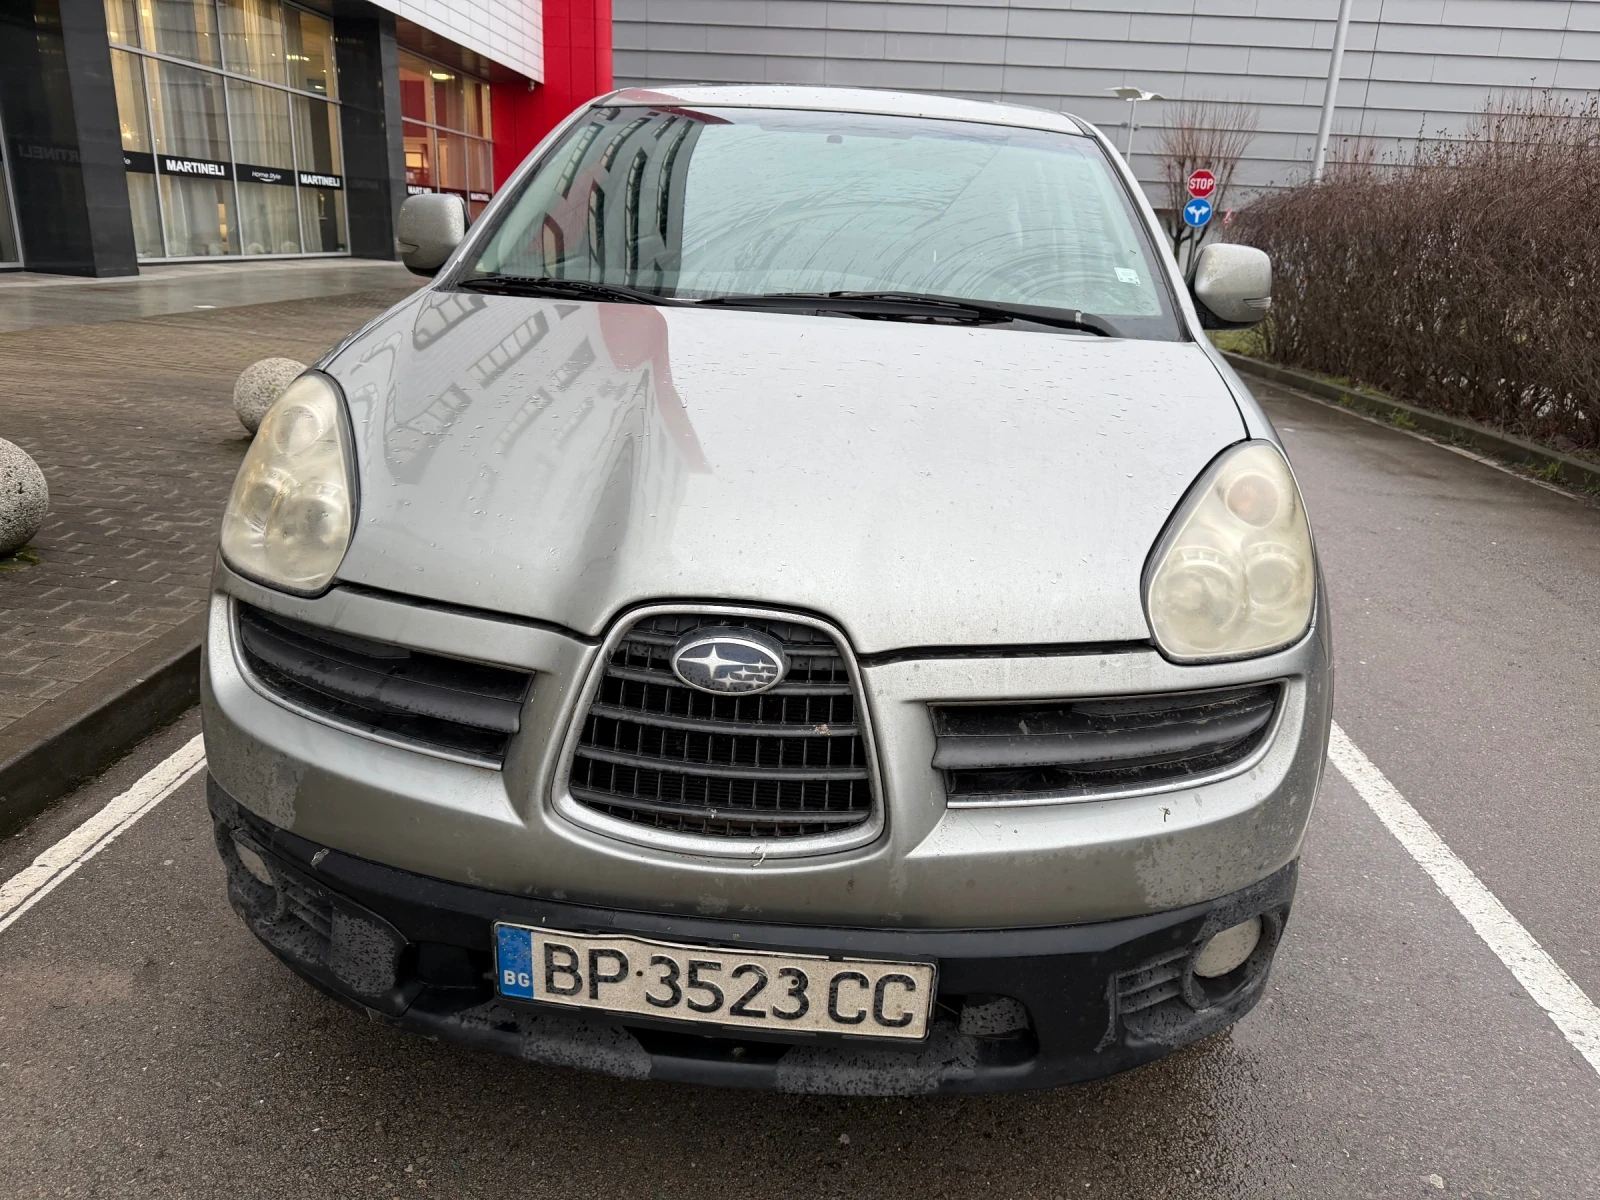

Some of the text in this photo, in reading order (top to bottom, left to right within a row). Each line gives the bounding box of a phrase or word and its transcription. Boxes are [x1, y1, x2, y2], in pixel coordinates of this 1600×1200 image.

[165, 159, 225, 176] MARTINELI
[251, 170, 282, 181] Home Style
[300, 173, 341, 187] MARTINELI
[1189, 177, 1214, 190] STOP
[503, 969, 530, 988] BG
[543, 942, 917, 1028] BP 3523 CC
